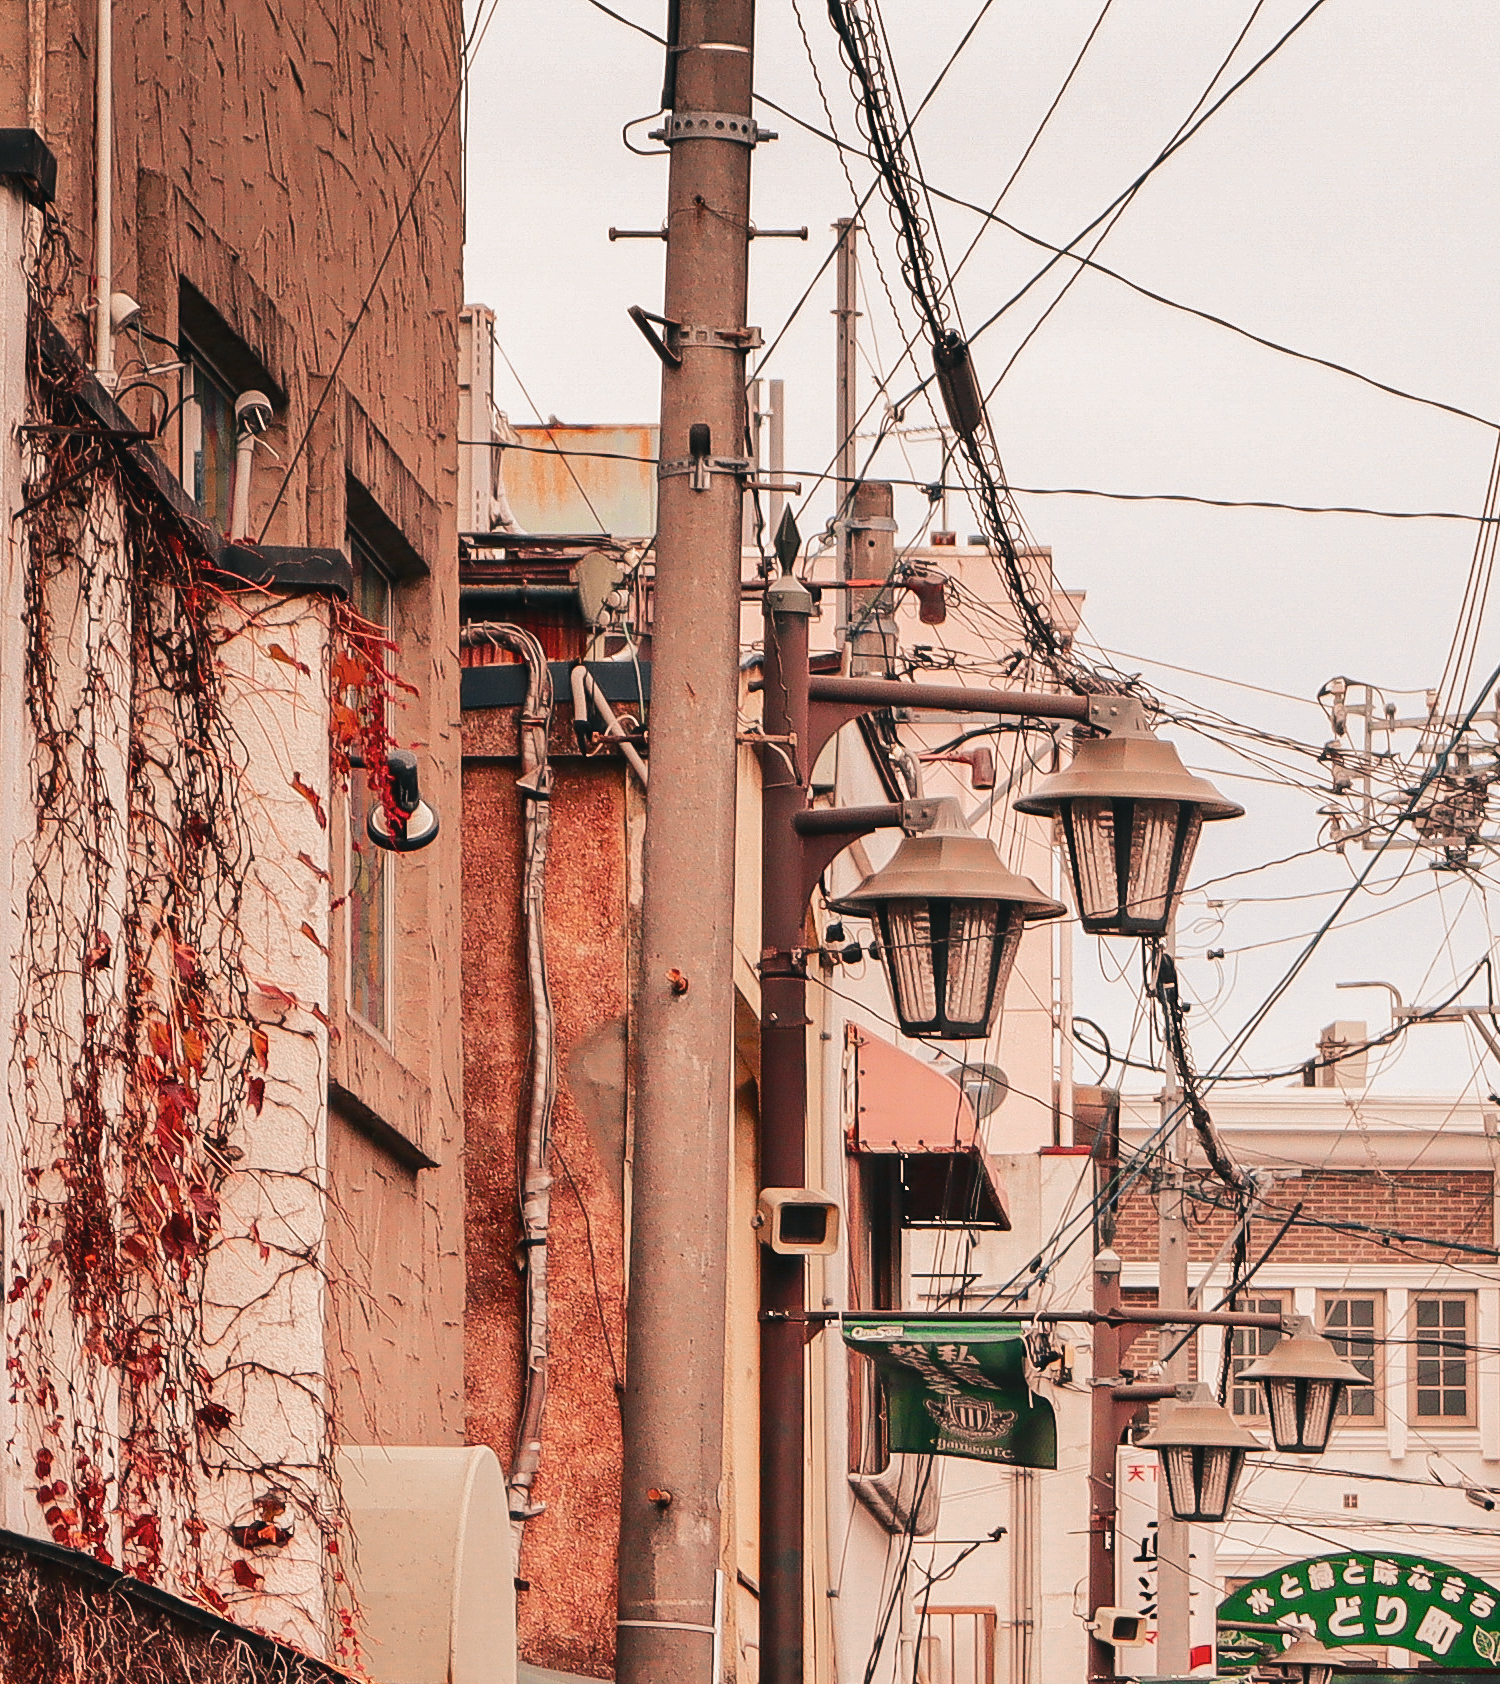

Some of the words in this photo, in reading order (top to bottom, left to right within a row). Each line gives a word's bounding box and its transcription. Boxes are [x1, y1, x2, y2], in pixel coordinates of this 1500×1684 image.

[1245, 1557, 1497, 1619] 水と緑と味なまち
